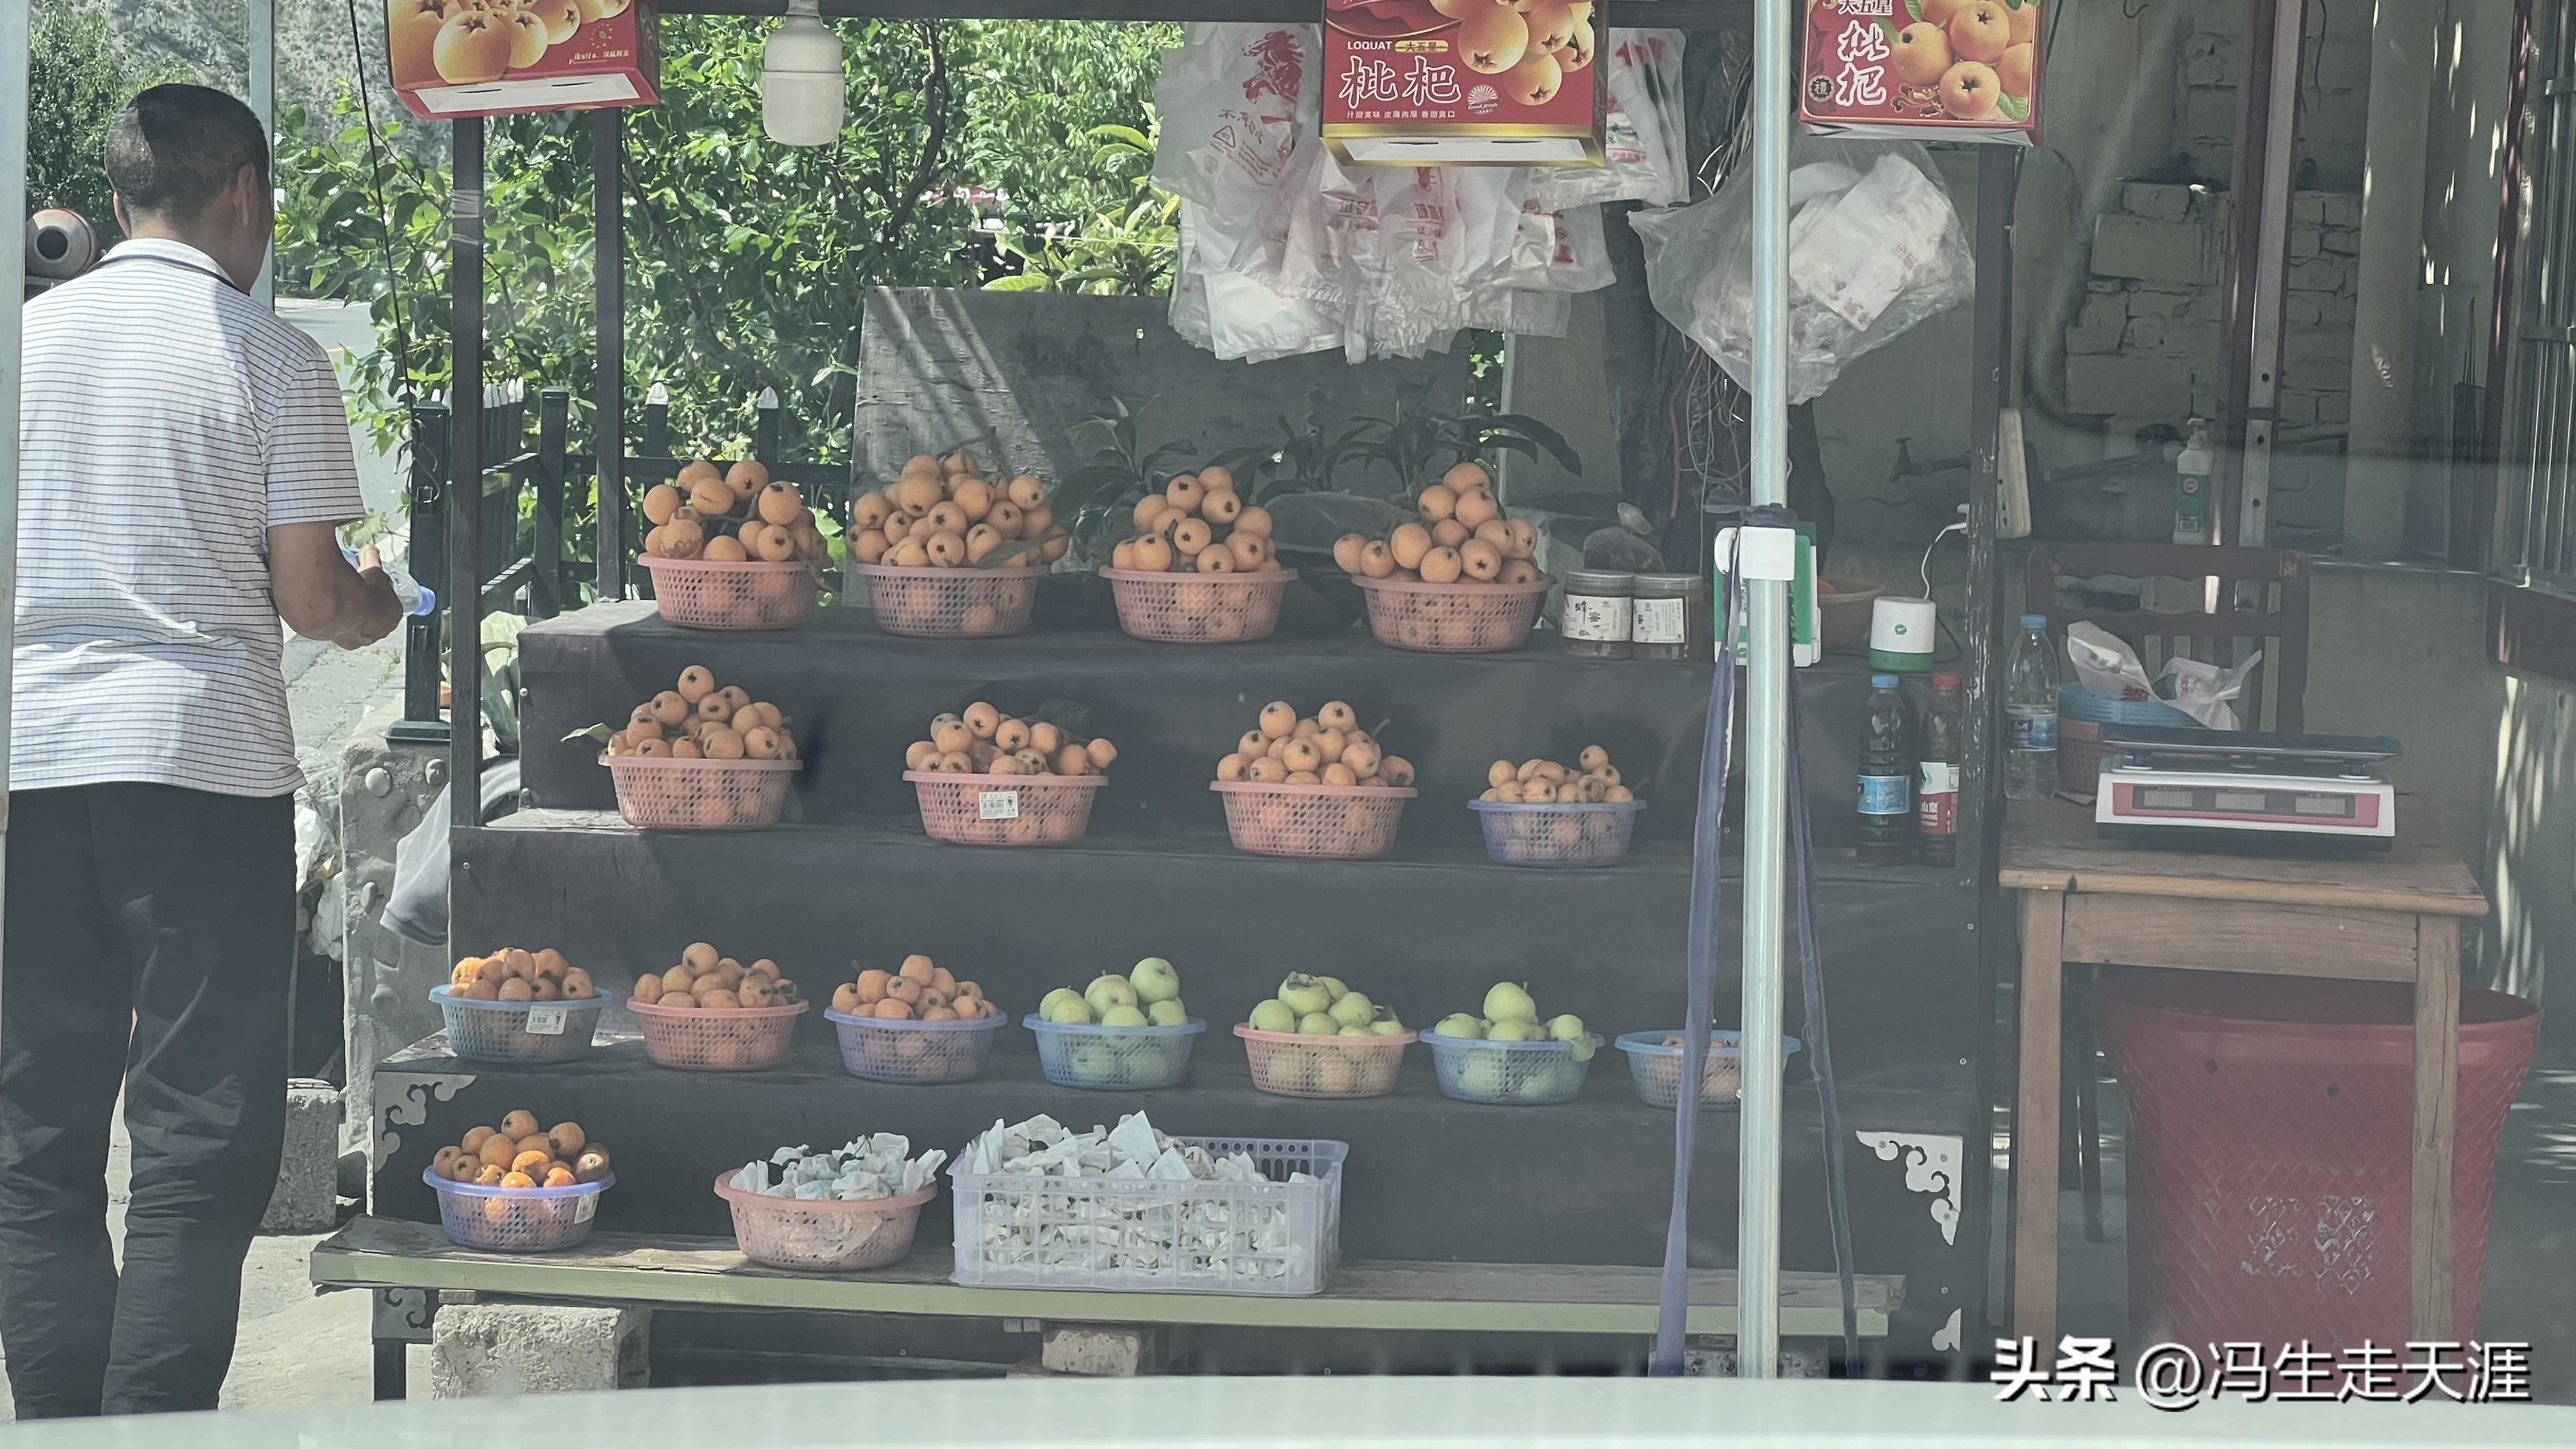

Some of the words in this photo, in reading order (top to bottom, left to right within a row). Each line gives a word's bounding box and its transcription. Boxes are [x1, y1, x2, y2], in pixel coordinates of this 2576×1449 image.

[1347, 41, 1392, 50] LOQUAT
[1836, 20, 1890, 107] 枇杷
[1338, 56, 1462, 109] 枇杷
